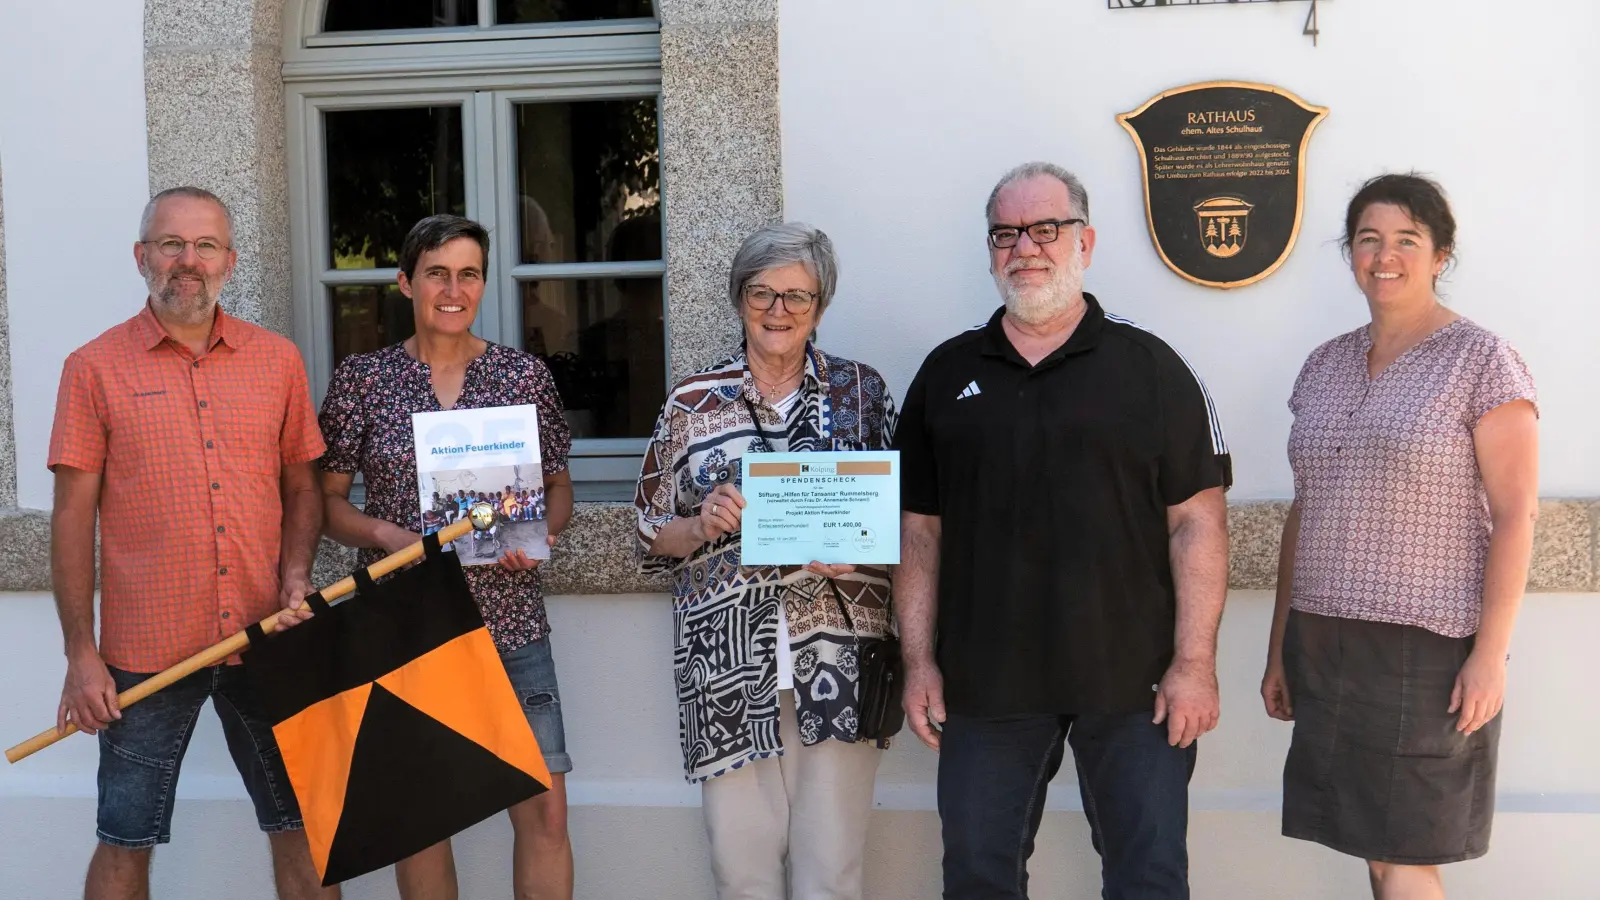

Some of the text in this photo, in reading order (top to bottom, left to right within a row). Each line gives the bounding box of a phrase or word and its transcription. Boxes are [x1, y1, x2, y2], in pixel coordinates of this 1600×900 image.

[1303, 0, 1319, 47] 4
[1187, 109, 1256, 124] RATHAUS
[1181, 125, 1263, 135] ehem. Altes Schulhaus
[1244, 142, 1291, 151] eingeschossiges
[1214, 161, 1265, 169] Lehrerwohnhaus
[431, 446, 464, 455] Aktion
[465, 440, 526, 453] Feuerkinder
[810, 465, 835, 474] Kolping
[780, 476, 856, 484] SPENDENSCHECK
